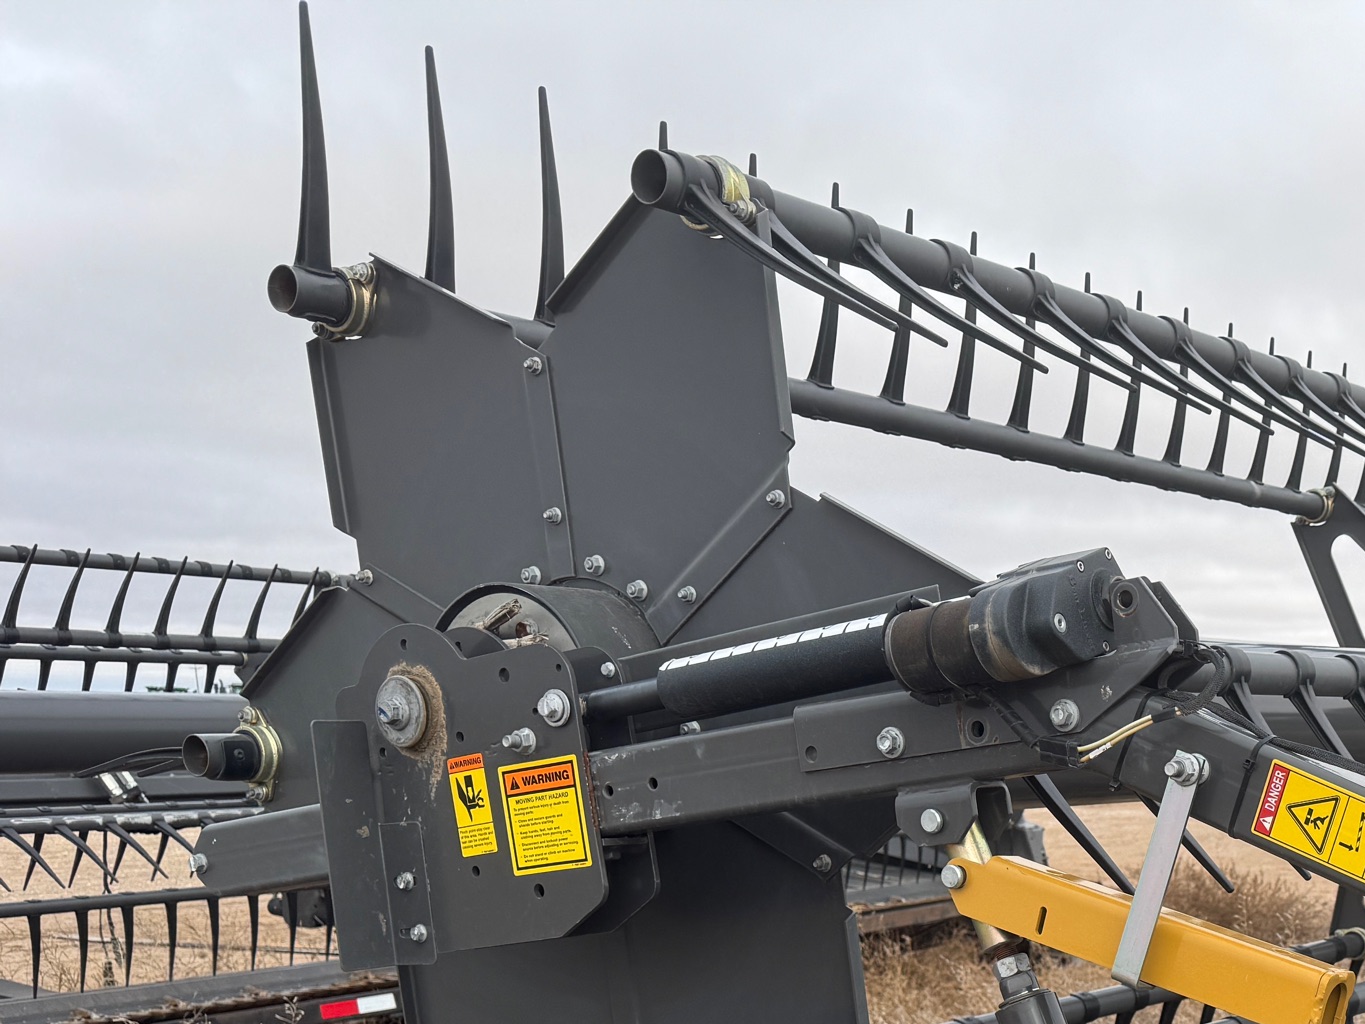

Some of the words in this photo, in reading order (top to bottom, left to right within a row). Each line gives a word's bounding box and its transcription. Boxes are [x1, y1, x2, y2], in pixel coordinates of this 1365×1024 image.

[453, 757, 482, 768] WARNING
[521, 769, 570, 787] WARNING
[548, 791, 568, 799] HAZARD
[1265, 770, 1287, 812] DANGER
